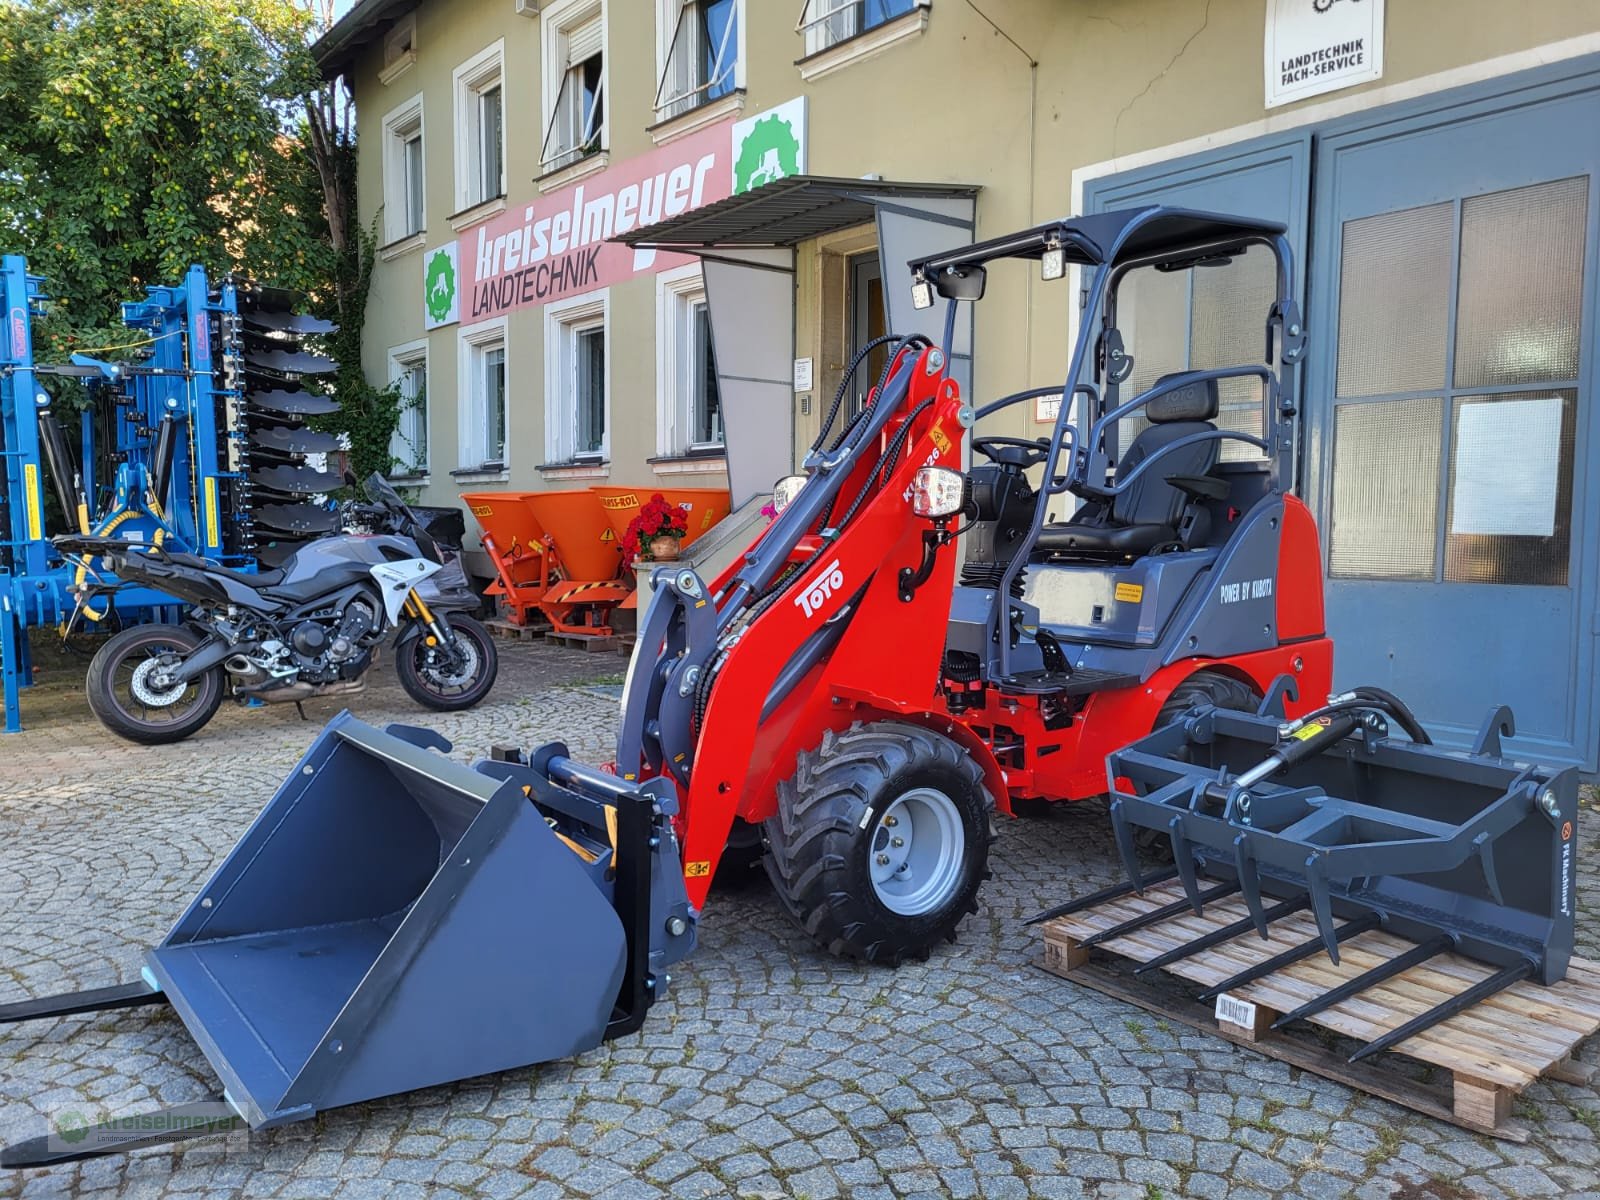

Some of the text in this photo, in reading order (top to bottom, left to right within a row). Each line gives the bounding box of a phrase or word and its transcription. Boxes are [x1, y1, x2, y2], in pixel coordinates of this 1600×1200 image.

[1281, 39, 1363, 72] LANDTECHNIK
[1281, 53, 1363, 86] FACH-SERVICE
[474, 152, 716, 282] kreiselmeyer
[471, 244, 602, 318] LANDTECHNIK
[794, 558, 843, 619] TOYO
[1220, 583, 1240, 604] POWER
[1241, 581, 1250, 601] BY
